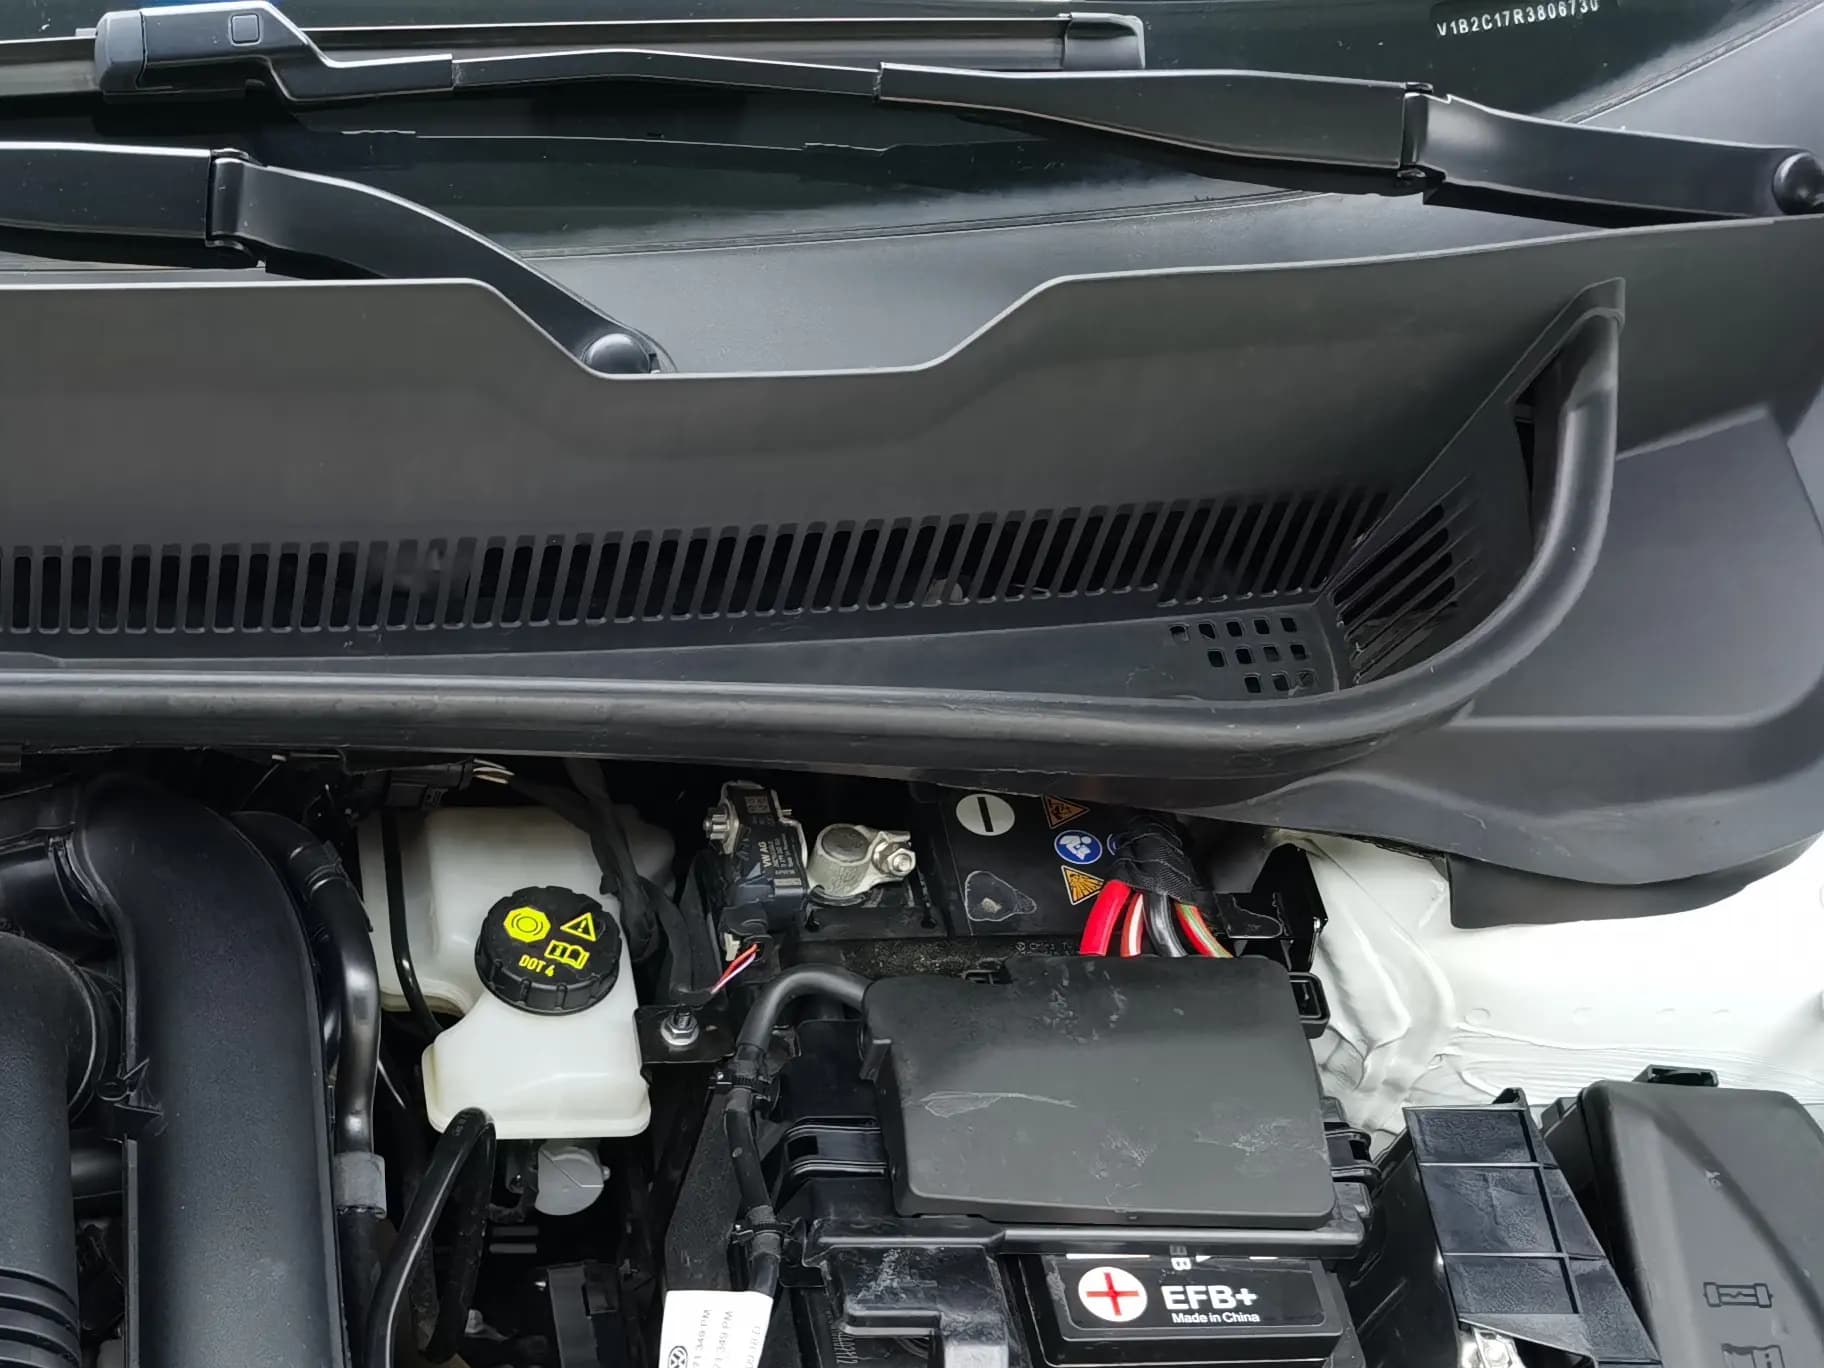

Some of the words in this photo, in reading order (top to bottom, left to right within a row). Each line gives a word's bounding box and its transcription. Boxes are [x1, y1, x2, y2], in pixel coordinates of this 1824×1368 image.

[518, 954, 545, 972] DOT
[545, 964, 555, 977] 4
[1160, 1284, 1259, 1310] EFB+
[1171, 1312, 1207, 1323] Made
[1209, 1312, 1221, 1323] in
[1222, 1311, 1260, 1323] China
